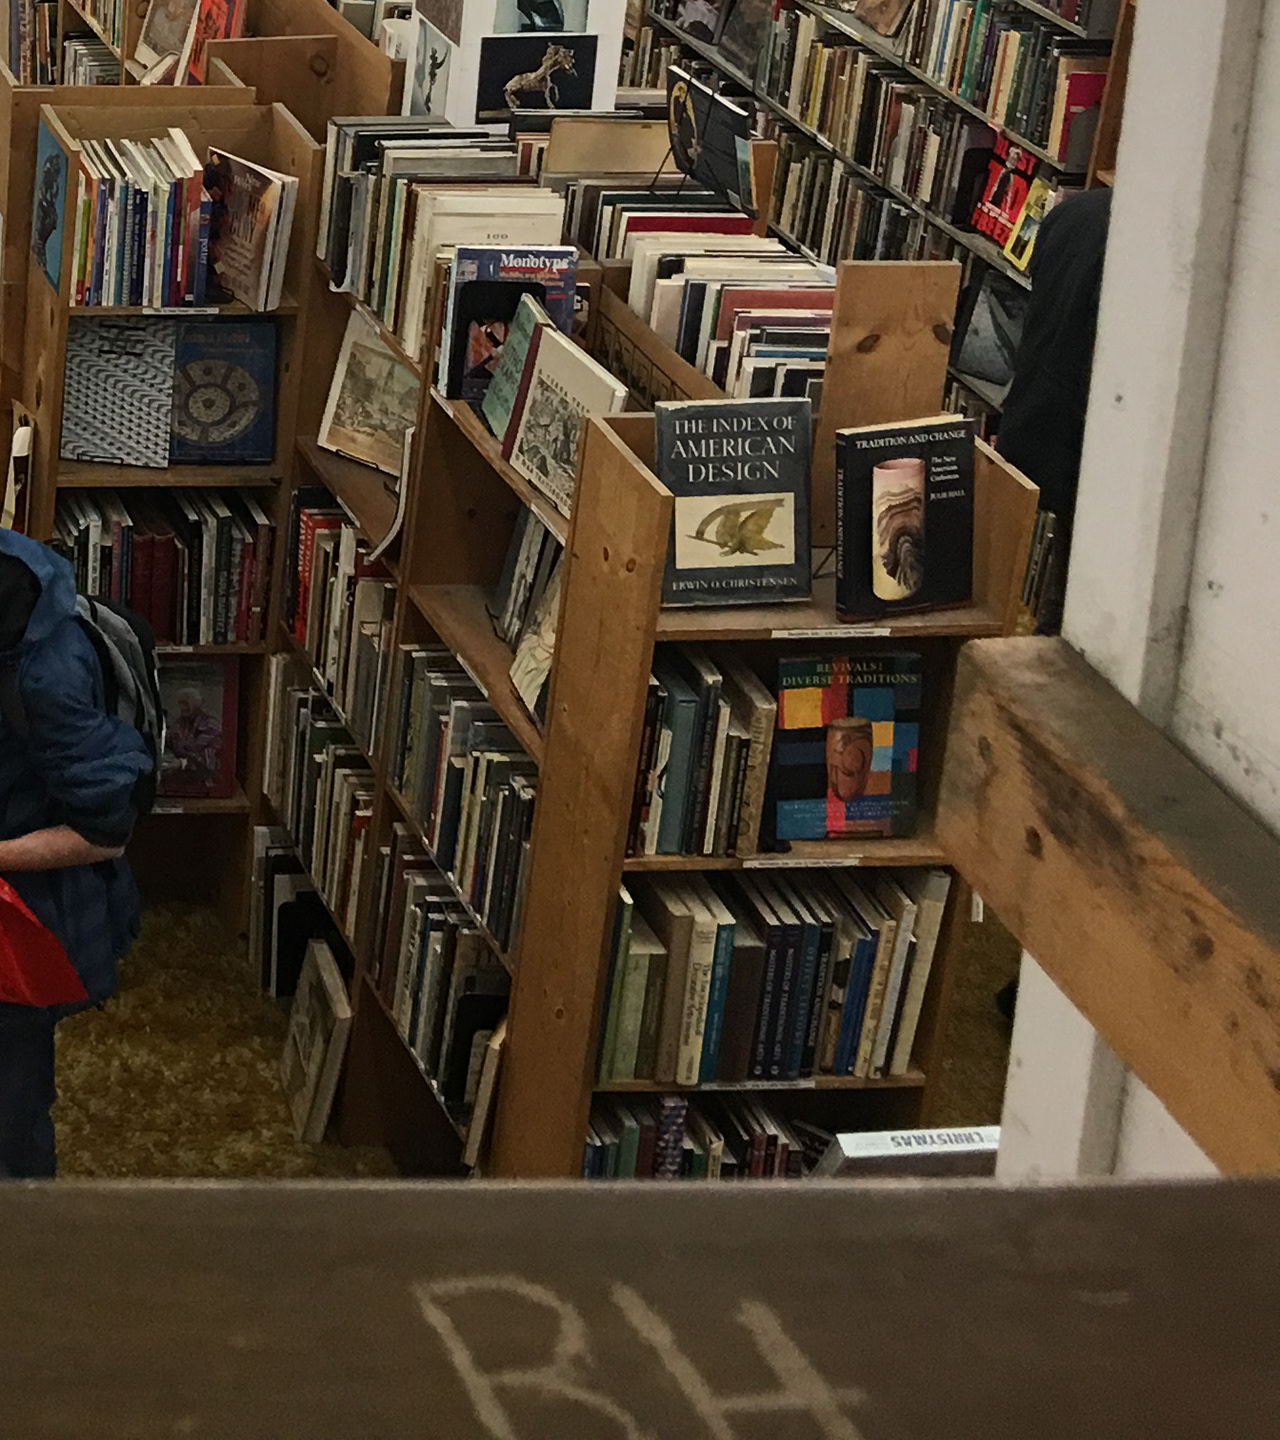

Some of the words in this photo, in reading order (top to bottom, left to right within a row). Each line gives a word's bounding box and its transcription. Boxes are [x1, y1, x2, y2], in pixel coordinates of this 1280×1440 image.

[500, 253, 570, 274] Monotype
[673, 419, 708, 435] THE
[712, 416, 769, 433] INDEX
[773, 415, 798, 431] OF
[671, 436, 795, 459] AMERICAN
[855, 436, 907, 450] TRADITION
[908, 434, 928, 444] AND
[929, 429, 967, 442] CHANGE
[688, 460, 780, 483] DESIGN
[673, 580, 708, 591] ERWIN
[721, 577, 798, 589] CHRISTENSEN
[782, 674, 834, 686] DIVERSE
[839, 673, 917, 684] TRADITIONS
[890, 1131, 984, 1148] CHRISTMAS
